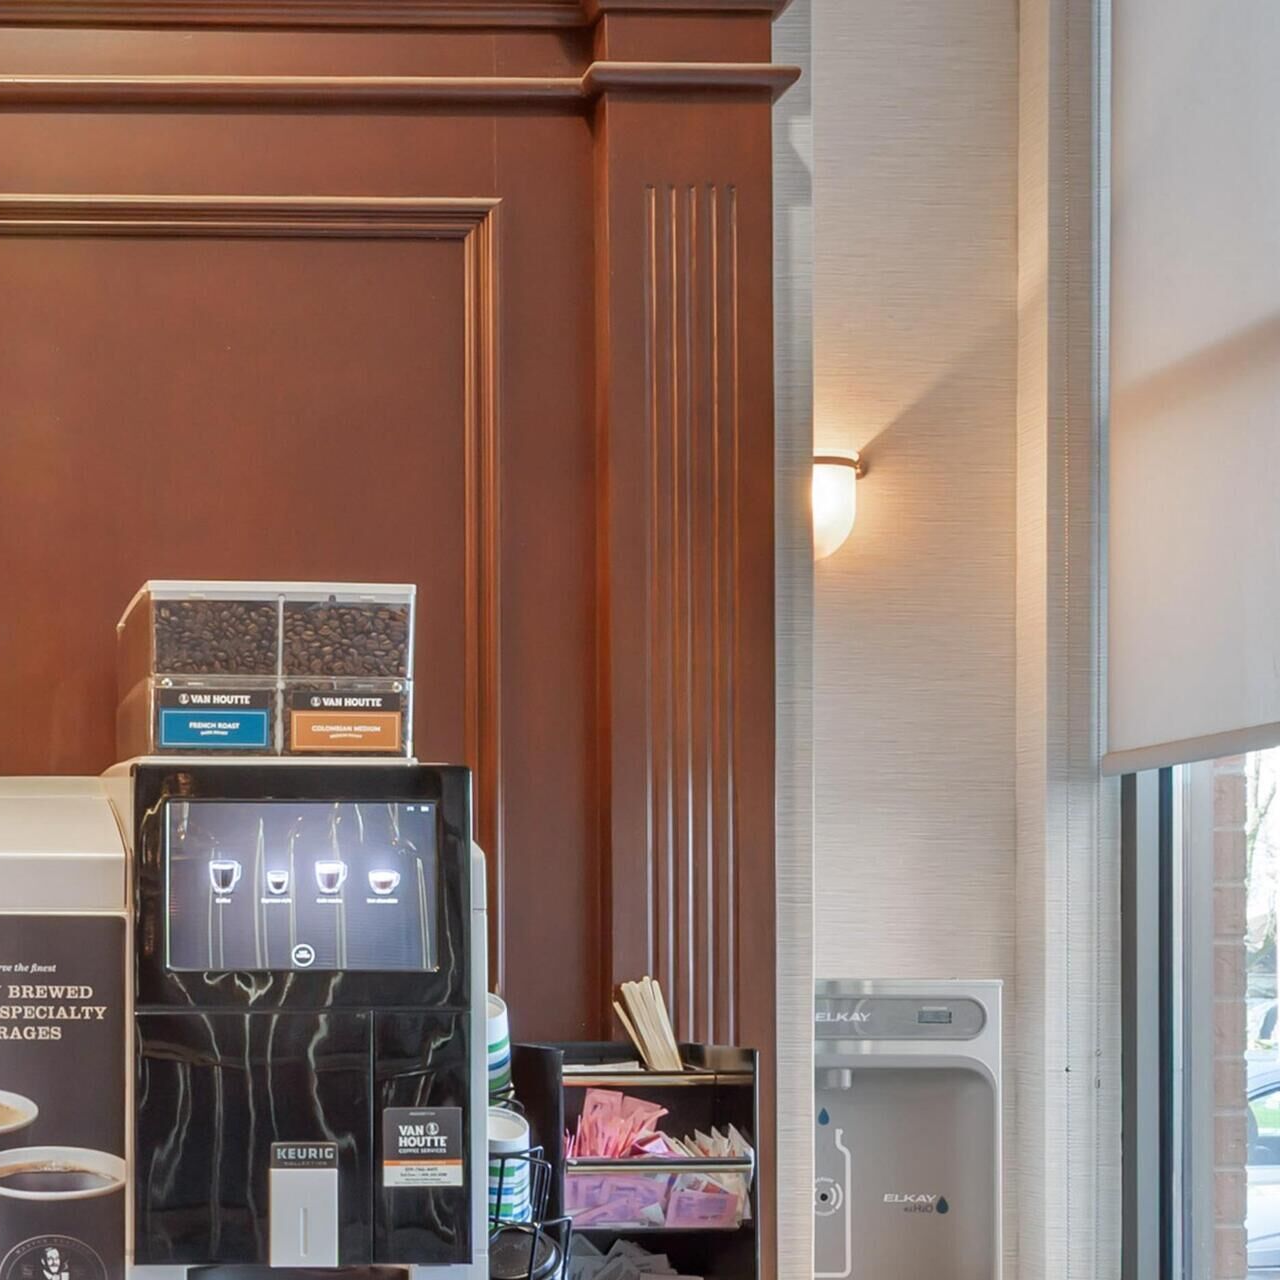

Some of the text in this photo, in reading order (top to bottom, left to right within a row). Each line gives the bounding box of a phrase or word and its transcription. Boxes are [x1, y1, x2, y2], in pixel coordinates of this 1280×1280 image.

[190, 694, 251, 704] VAN HOUTTE
[322, 697, 383, 707] VAN HOUTTE
[14, 962, 29, 972] the
[30, 962, 57, 973] finest
[8, 985, 93, 999] BREWED
[0, 1006, 108, 1019] SPECIALTY
[815, 1012, 871, 1022] ELKAY
[398, 1125, 424, 1136] VAN
[398, 1136, 448, 1147] HOUTTE
[276, 1147, 335, 1159] KEURIG
[883, 1193, 937, 1203] ELKAY
